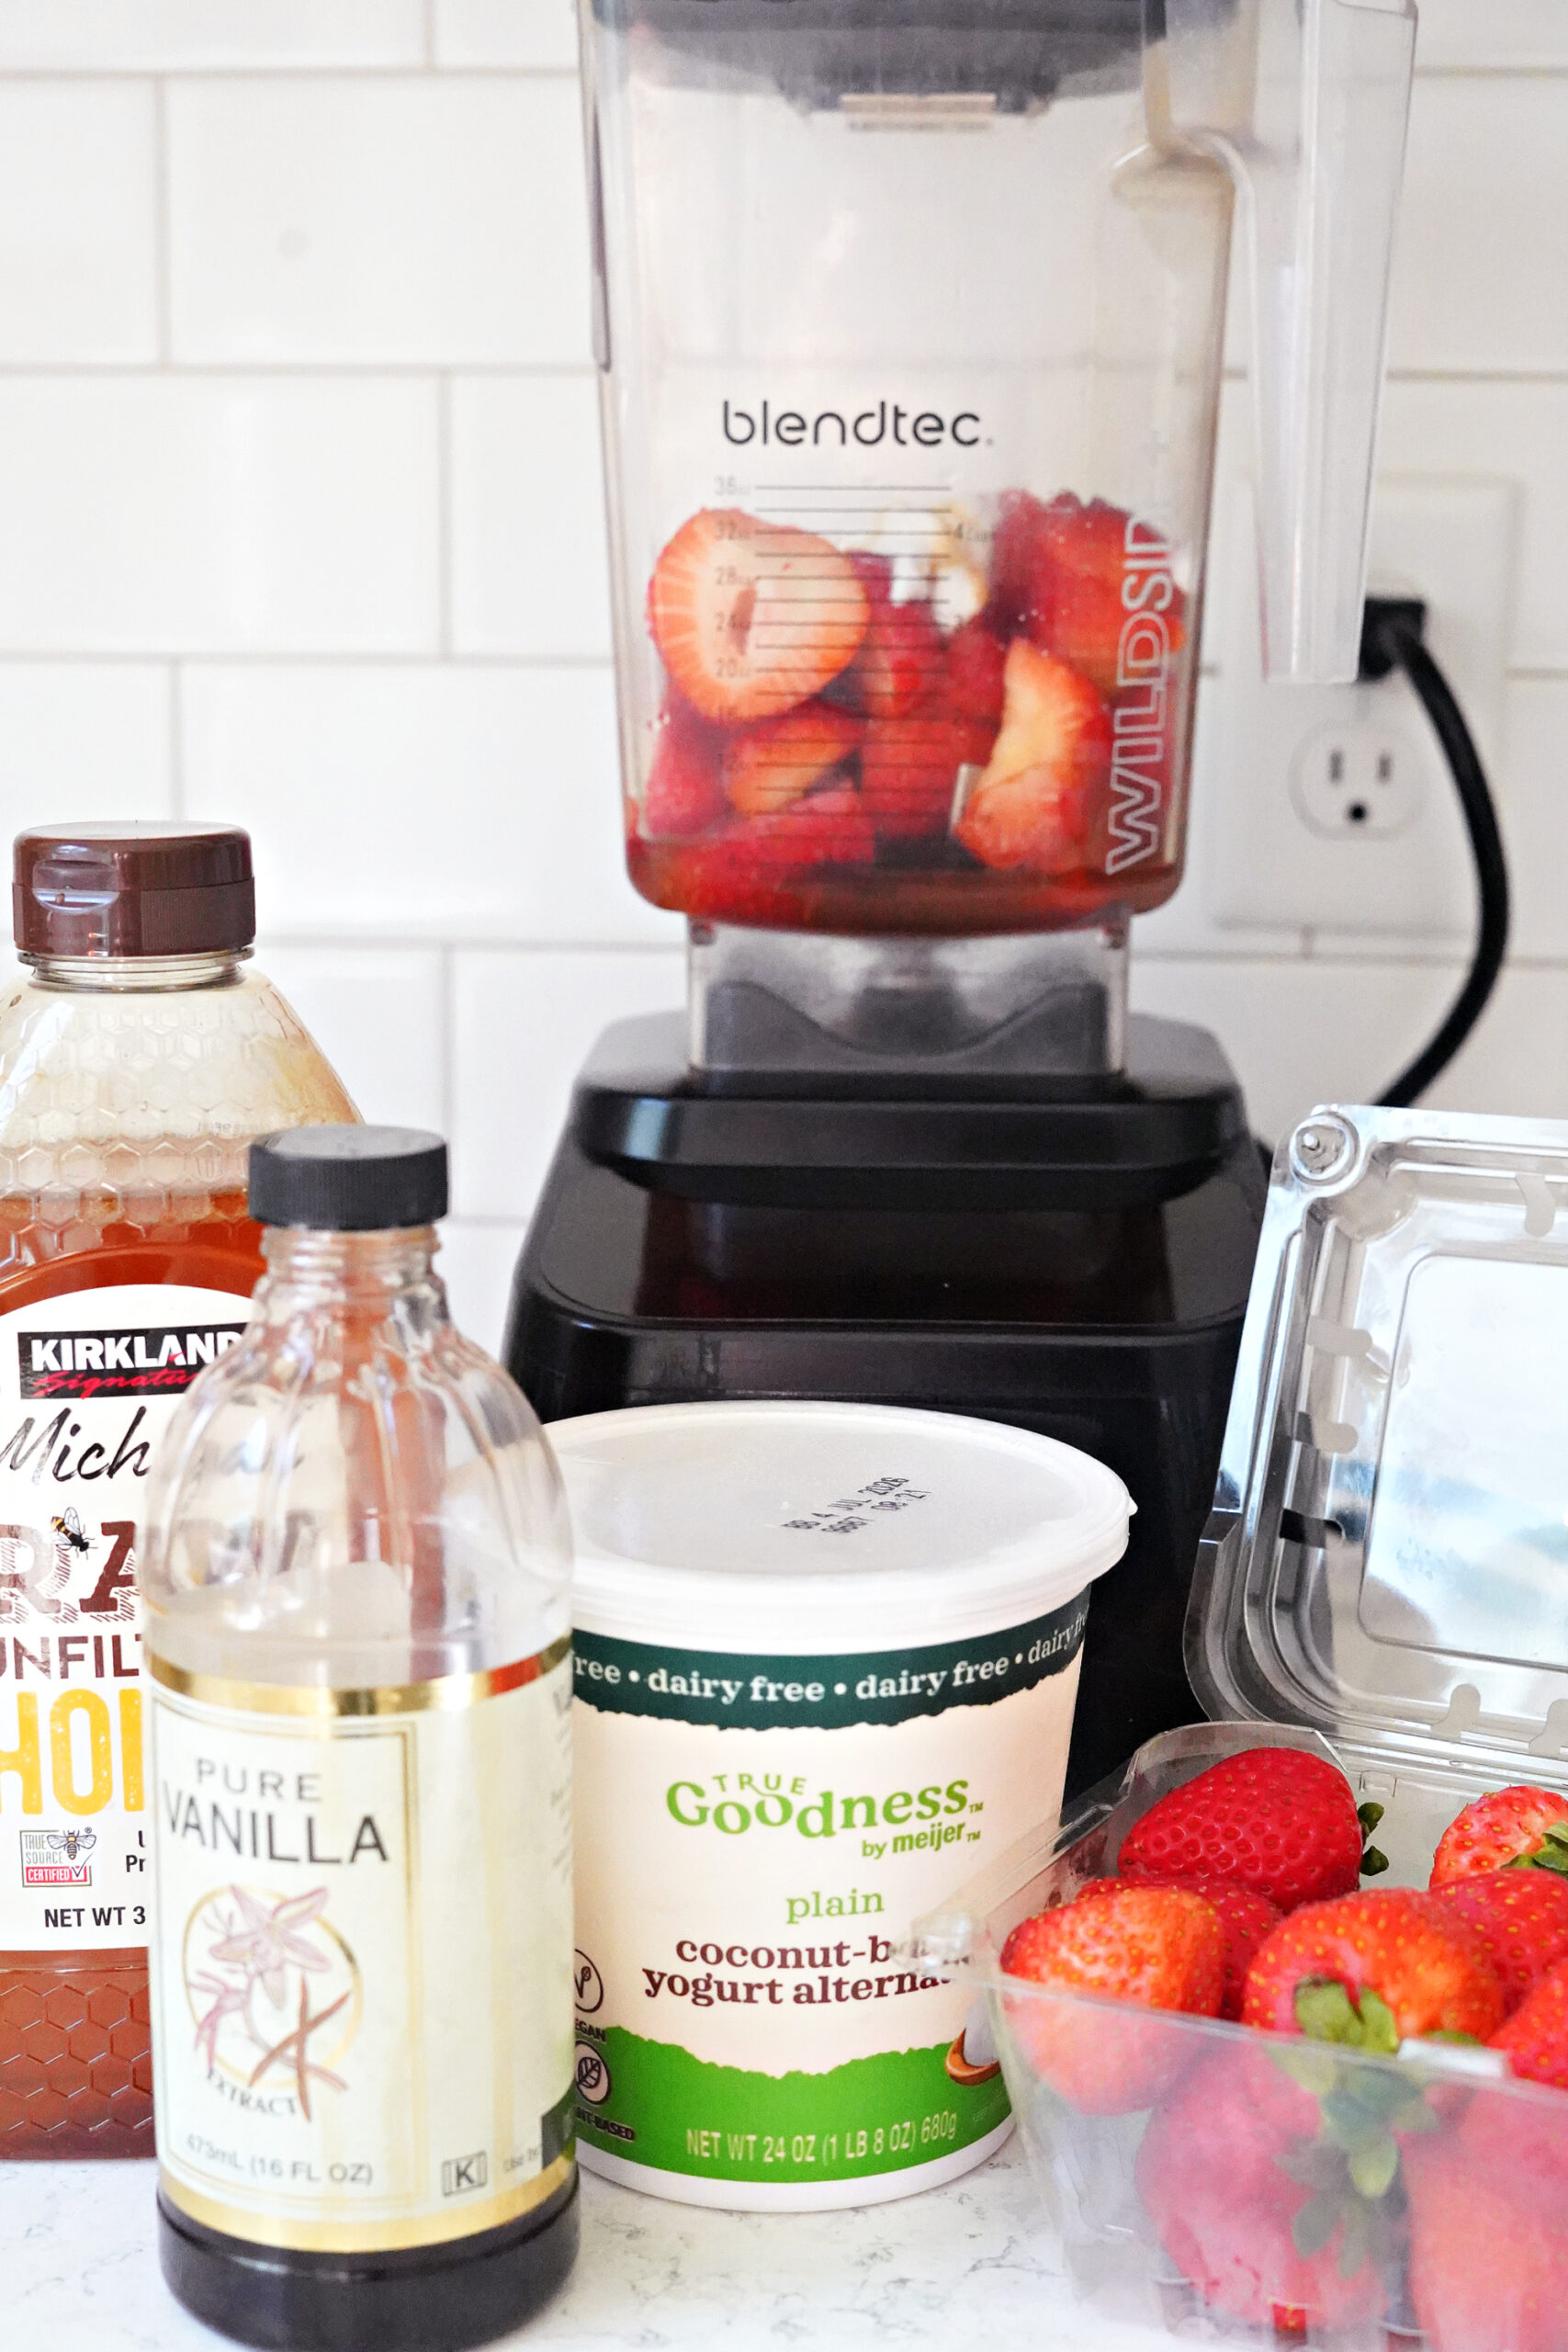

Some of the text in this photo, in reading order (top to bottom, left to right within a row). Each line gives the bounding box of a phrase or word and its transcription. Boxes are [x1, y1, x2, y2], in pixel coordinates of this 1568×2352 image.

[723, 400, 980, 446] blendtec
[1105, 514, 1174, 876] WILDSID
[573, 1656, 622, 1684] ree
[648, 1668, 745, 1705] dairy
[750, 1675, 826, 1702] free
[854, 1669, 948, 1697] dairy
[951, 1657, 1010, 1687] free
[1027, 1629, 1074, 1665] dairy
[196, 1758, 323, 1802] PURE
[713, 1773, 807, 1795] TRUE
[163, 1779, 389, 1865] VANILLA
[666, 1780, 969, 1838] Goodness
[23, 1834, 47, 1849] TRUE
[26, 1851, 63, 1864] SOURCE
[862, 1839, 887, 1860] by
[892, 1823, 966, 1852] meijer
[28, 1869, 71, 1882] CERTIFIED
[44, 1907, 85, 1928] NET
[92, 1906, 127, 1927] WT
[785, 1888, 886, 1925] plain
[642, 1967, 952, 2007] yogurt alterna
[574, 2018, 607, 2043] EGAN
[206, 2067, 299, 2115] EXTRACT
[686, 2110, 957, 2165] NET WT 24 OZ (1 LB 8 OZ) 680g
[249, 2154, 284, 2180] (16
[290, 2160, 321, 2184] FL
[328, 2161, 374, 2187] OZ)
